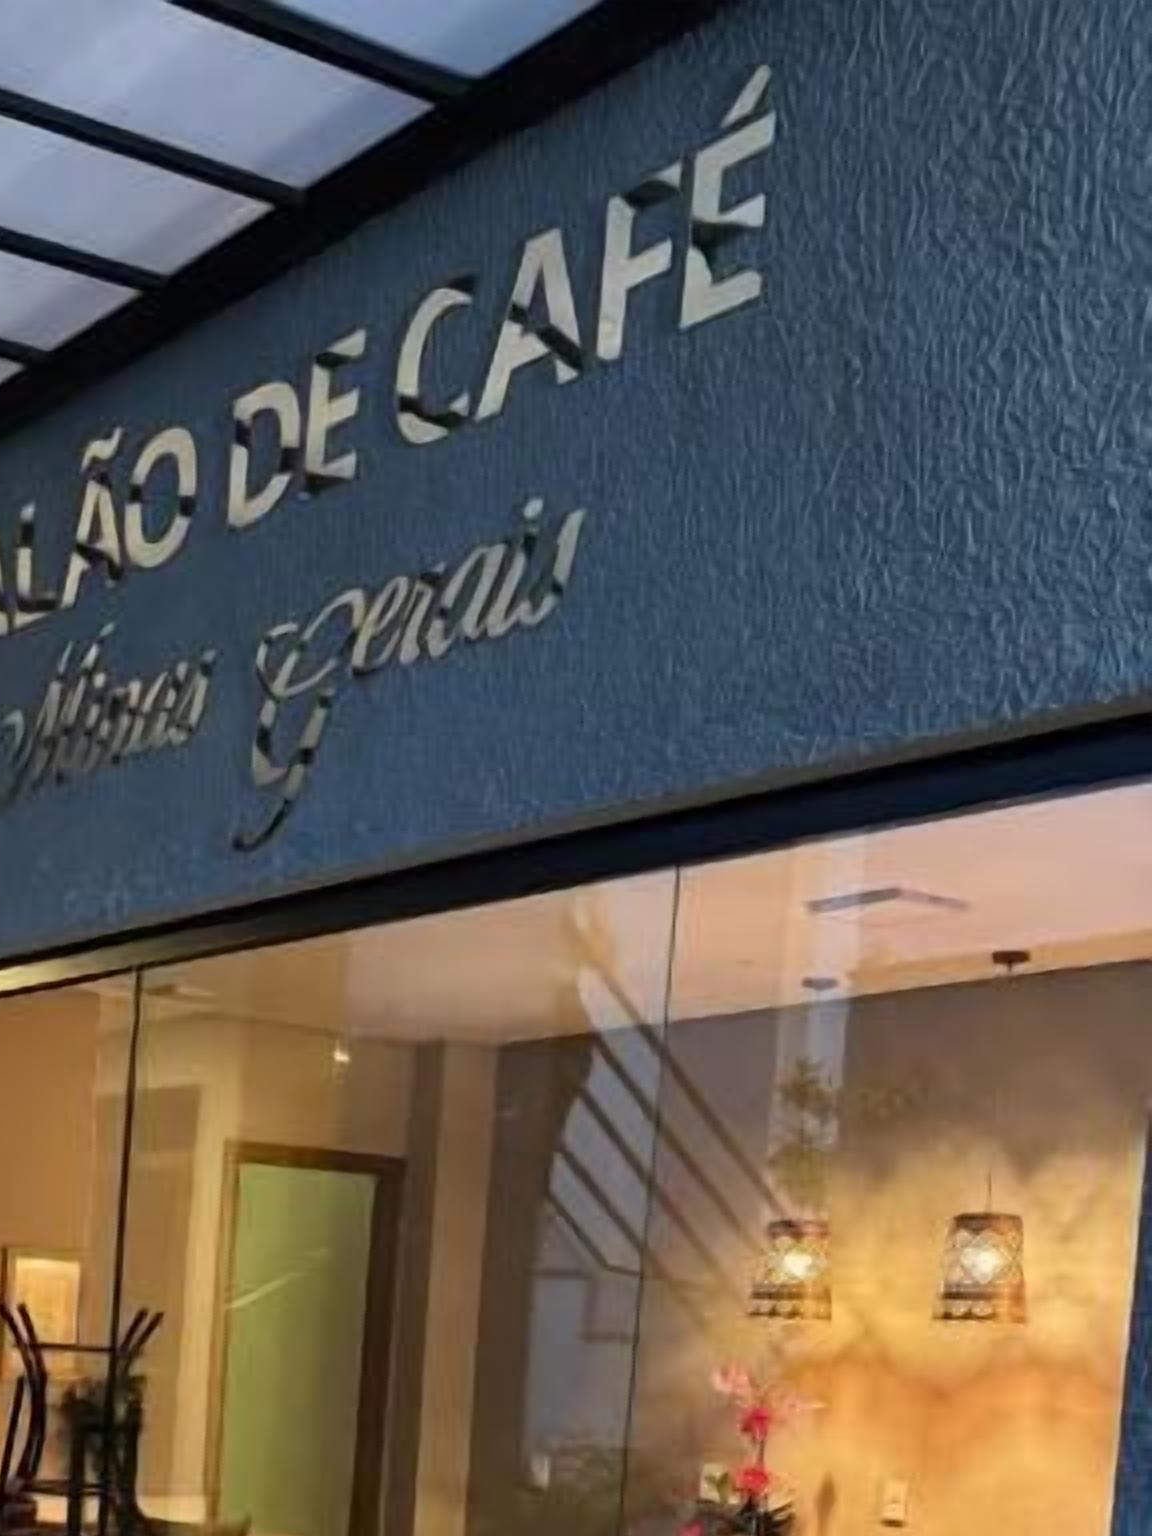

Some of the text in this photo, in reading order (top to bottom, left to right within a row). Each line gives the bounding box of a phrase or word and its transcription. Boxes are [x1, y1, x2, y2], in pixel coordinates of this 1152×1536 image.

[226, 328, 367, 530] DE
[395, 63, 778, 445] CAFÉ
[233, 497, 586, 851] Gerais
